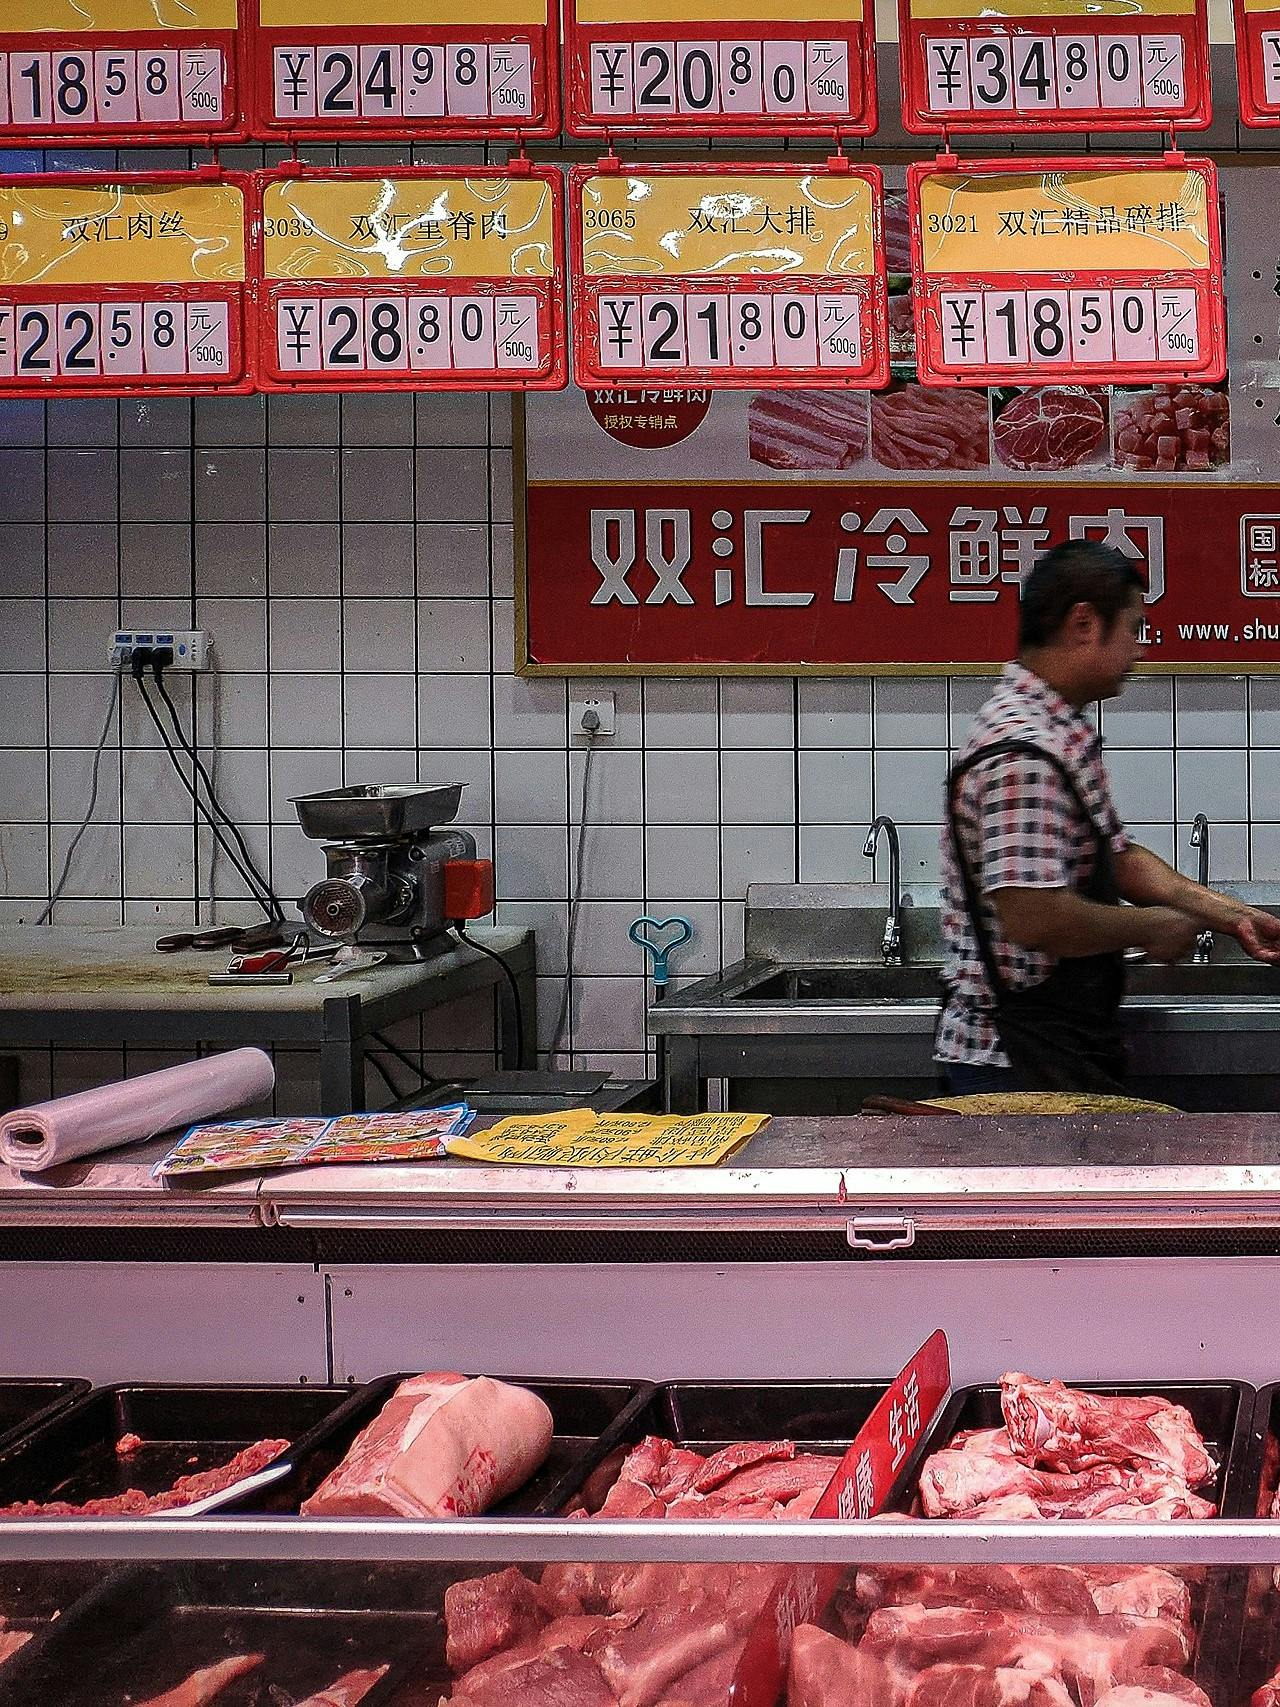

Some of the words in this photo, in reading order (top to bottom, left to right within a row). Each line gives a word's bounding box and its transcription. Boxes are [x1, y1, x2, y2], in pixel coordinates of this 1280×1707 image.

[585, 209, 637, 229] 3065
[928, 213, 979, 235] 3021
[604, 414, 678, 429] 授权专销点
[590, 506, 1166, 606] 双汇冷鲜肉
